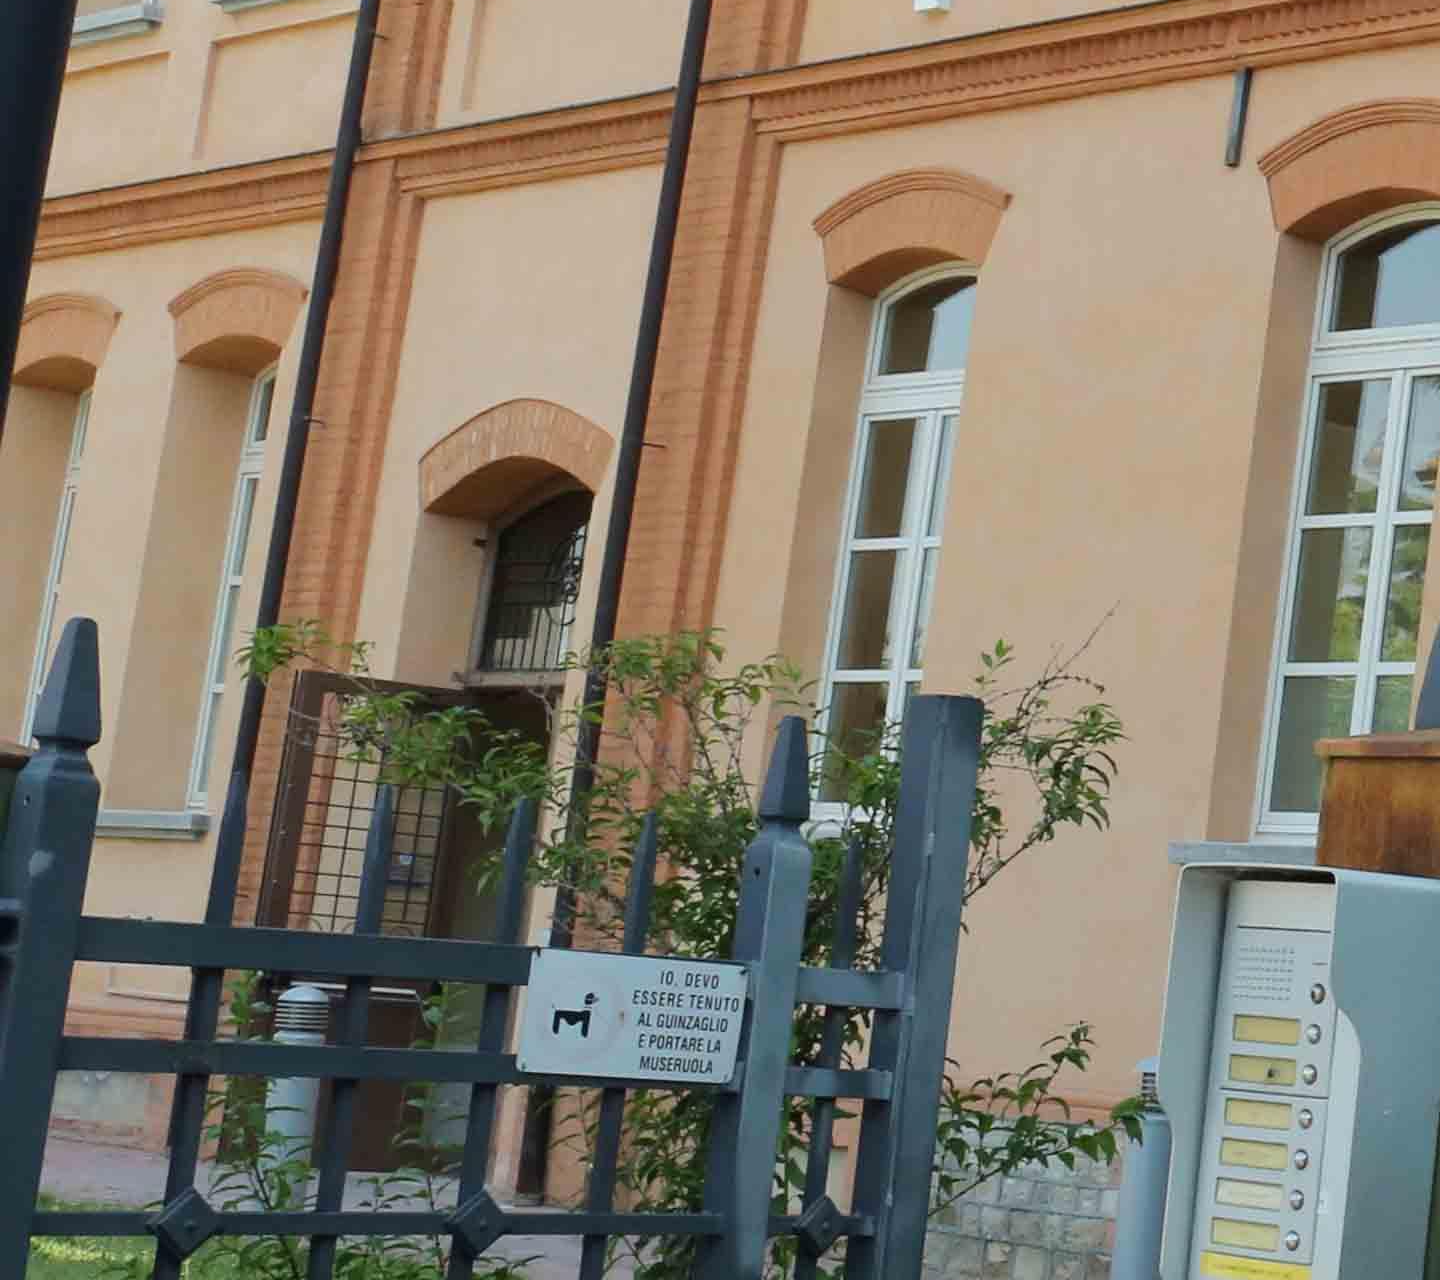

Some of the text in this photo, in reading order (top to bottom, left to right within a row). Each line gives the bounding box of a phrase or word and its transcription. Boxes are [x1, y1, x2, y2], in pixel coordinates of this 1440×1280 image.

[685, 972, 719, 989] DEVO
[632, 989, 740, 1012] ESSERE TENUTO
[637, 1012, 728, 1032] AL GUINZAGLIO
[638, 1033, 721, 1053] E PORTARE LA
[640, 1055, 713, 1074] MUSERUOLA
